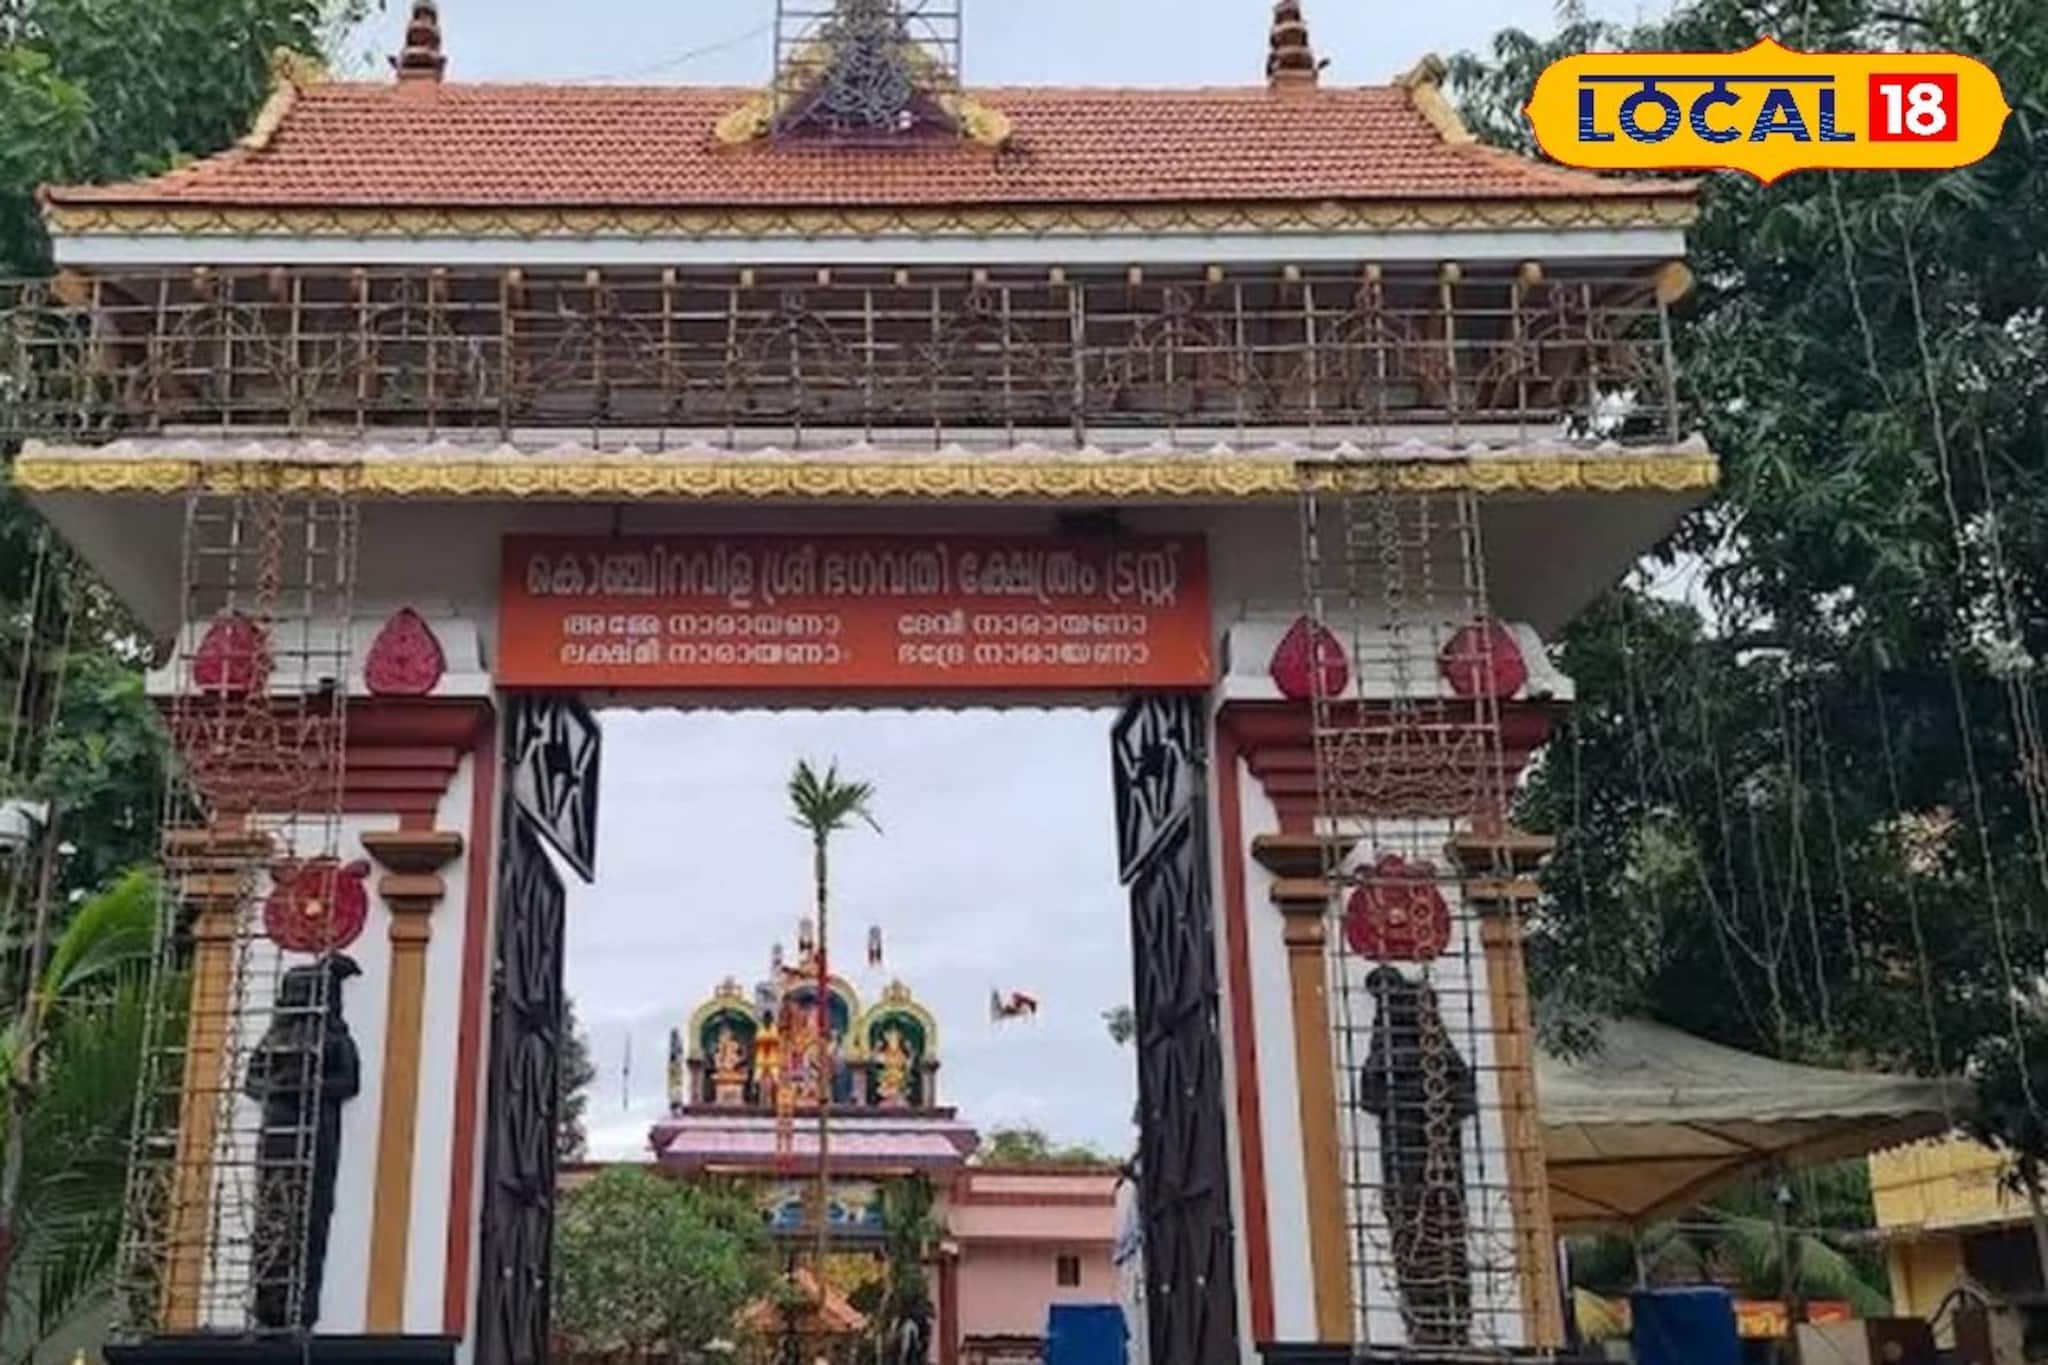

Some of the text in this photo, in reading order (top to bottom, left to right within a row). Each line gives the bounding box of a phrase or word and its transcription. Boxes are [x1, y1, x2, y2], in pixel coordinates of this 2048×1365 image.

[761, 547, 815, 606] ശ്രീ
[824, 547, 949, 595] ഭഗവതി
[959, 552, 1097, 605] ക്ഷേത്രം
[669, 614, 842, 636] നാരായണാ
[973, 614, 1147, 636] നാരായണാ
